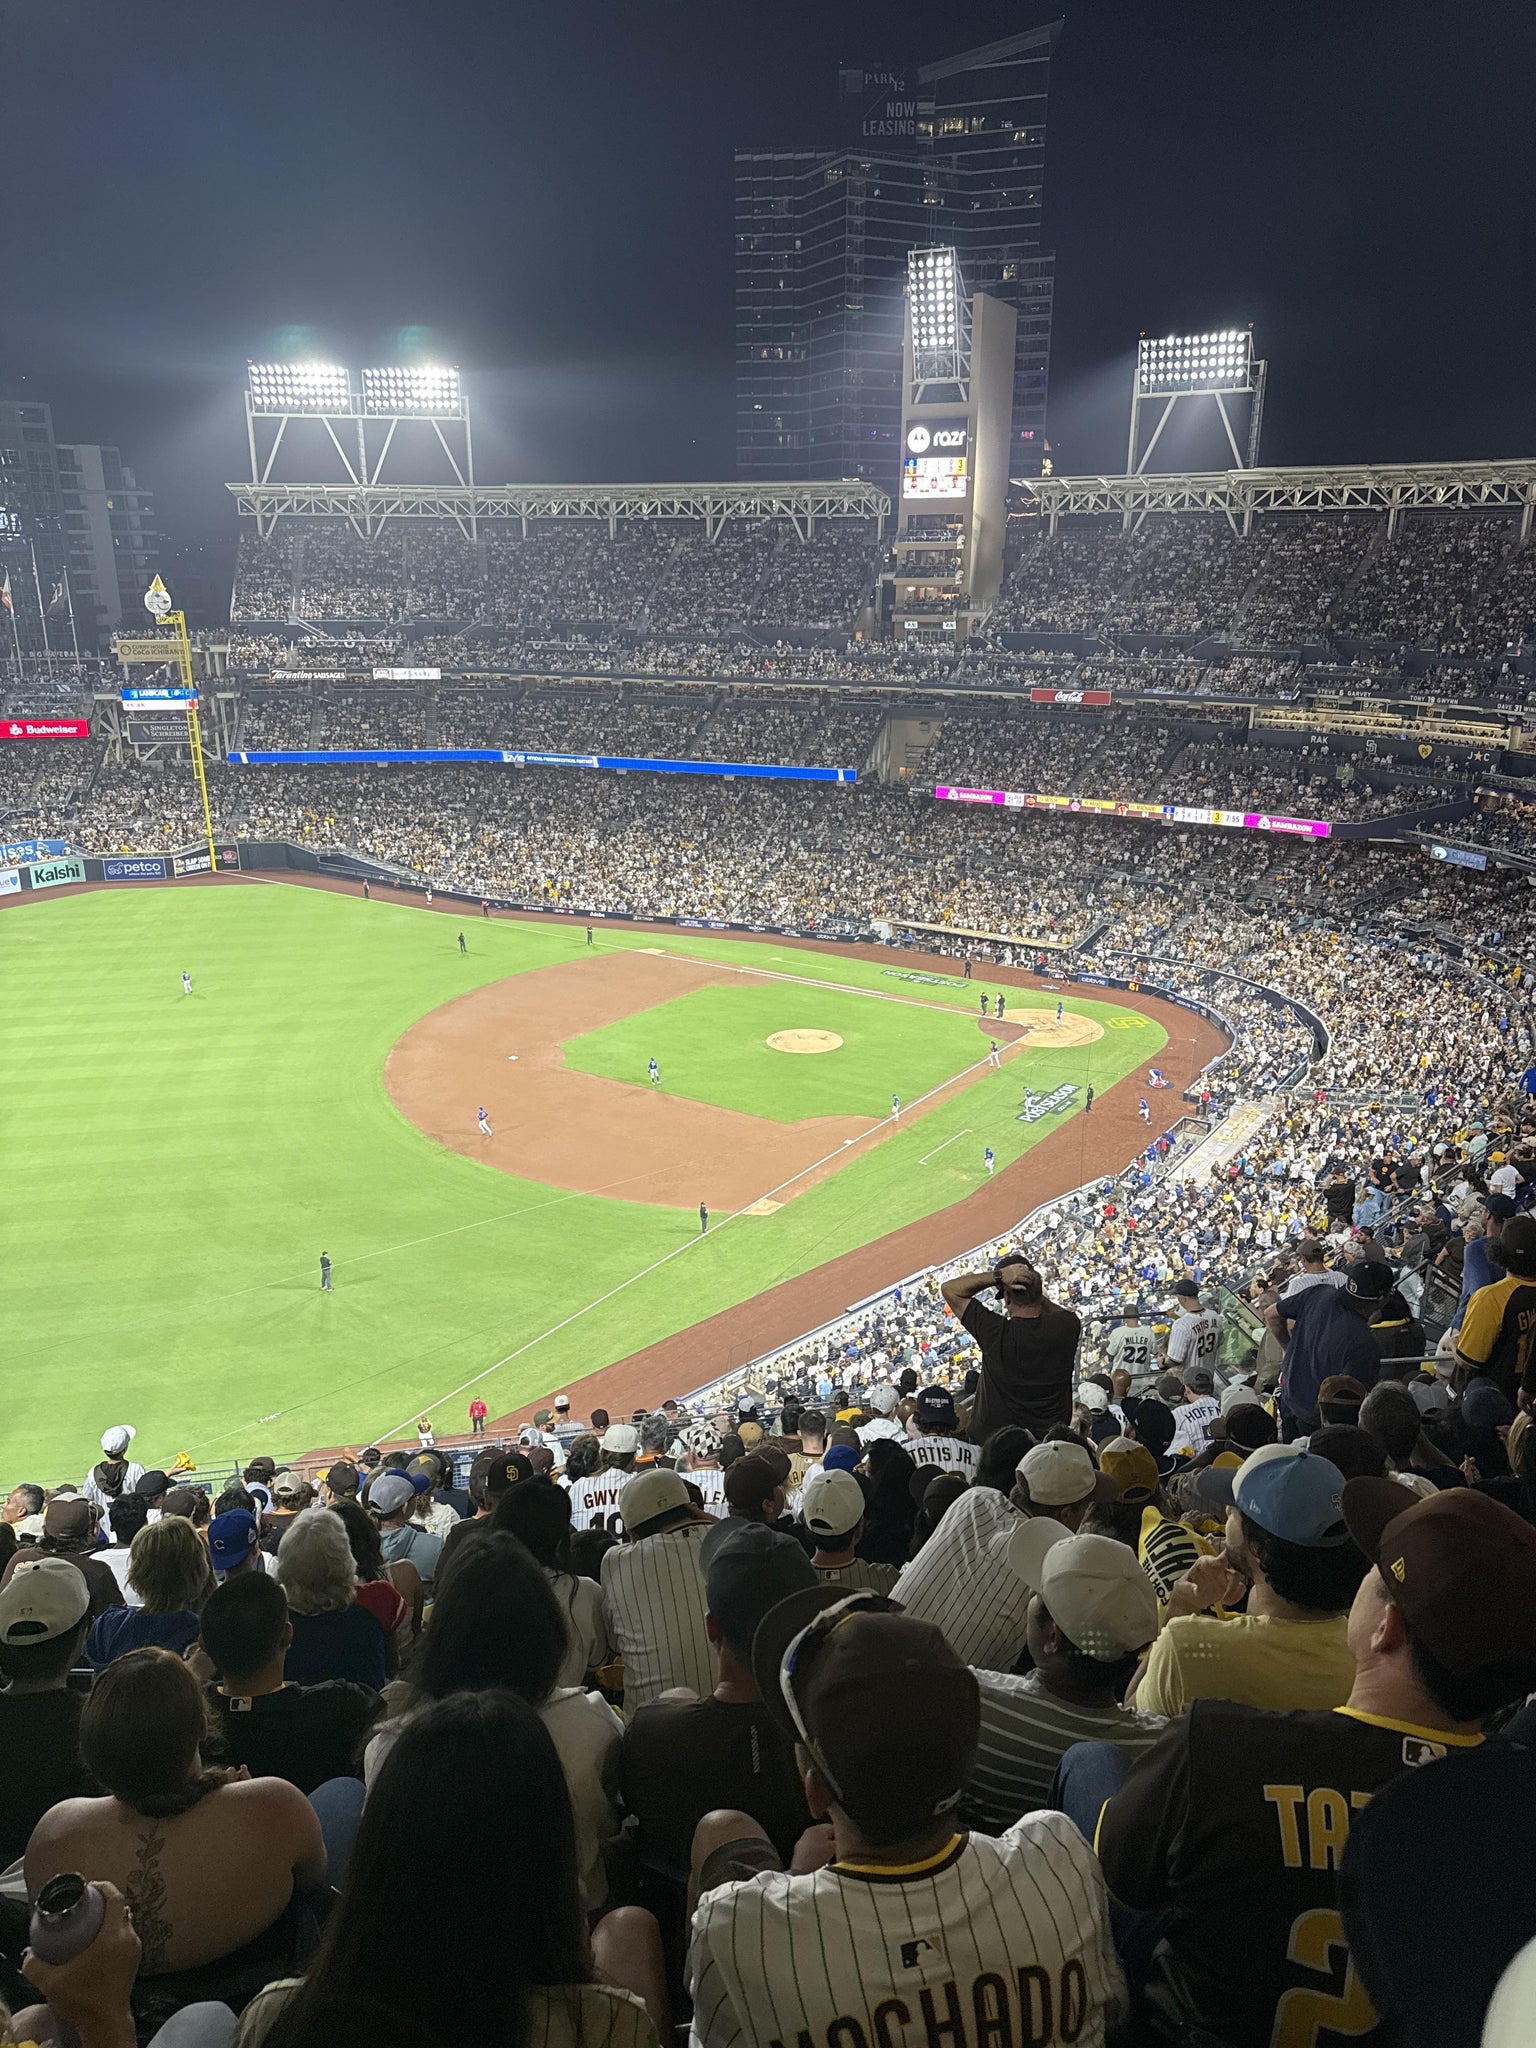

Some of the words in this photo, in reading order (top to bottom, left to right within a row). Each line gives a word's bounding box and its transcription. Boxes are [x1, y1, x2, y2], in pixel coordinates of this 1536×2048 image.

[886, 102, 916, 118] NOW
[862, 120, 915, 136] LEASING
[933, 431, 967, 447] razr
[271, 669, 312, 679] Tarantino
[1437, 697, 1459, 705] GWYNN
[26, 724, 79, 735] Budweiser
[1310, 735, 1328, 744] RAK
[1226, 815, 1240, 823] 7:55
[1272, 821, 1314, 832] SAMBAZON
[34, 864, 80, 883] Kalshi
[123, 862, 161, 875] petco
[1081, 977, 1106, 986] abbvie
[1018, 1083, 1079, 1122] POSTSEASON
[1192, 1319, 1209, 1335] TATIS
[1125, 1336, 1149, 1345] MILLER
[1197, 1332, 1216, 1358] 23
[1123, 1346, 1148, 1364] 22
[908, 1446, 951, 1465] TATIS
[956, 1447, 976, 1467] JR.
[506, 1465, 519, 1482] SD
[583, 1488, 622, 1510] GWY
[213, 1539, 225, 1550] C
